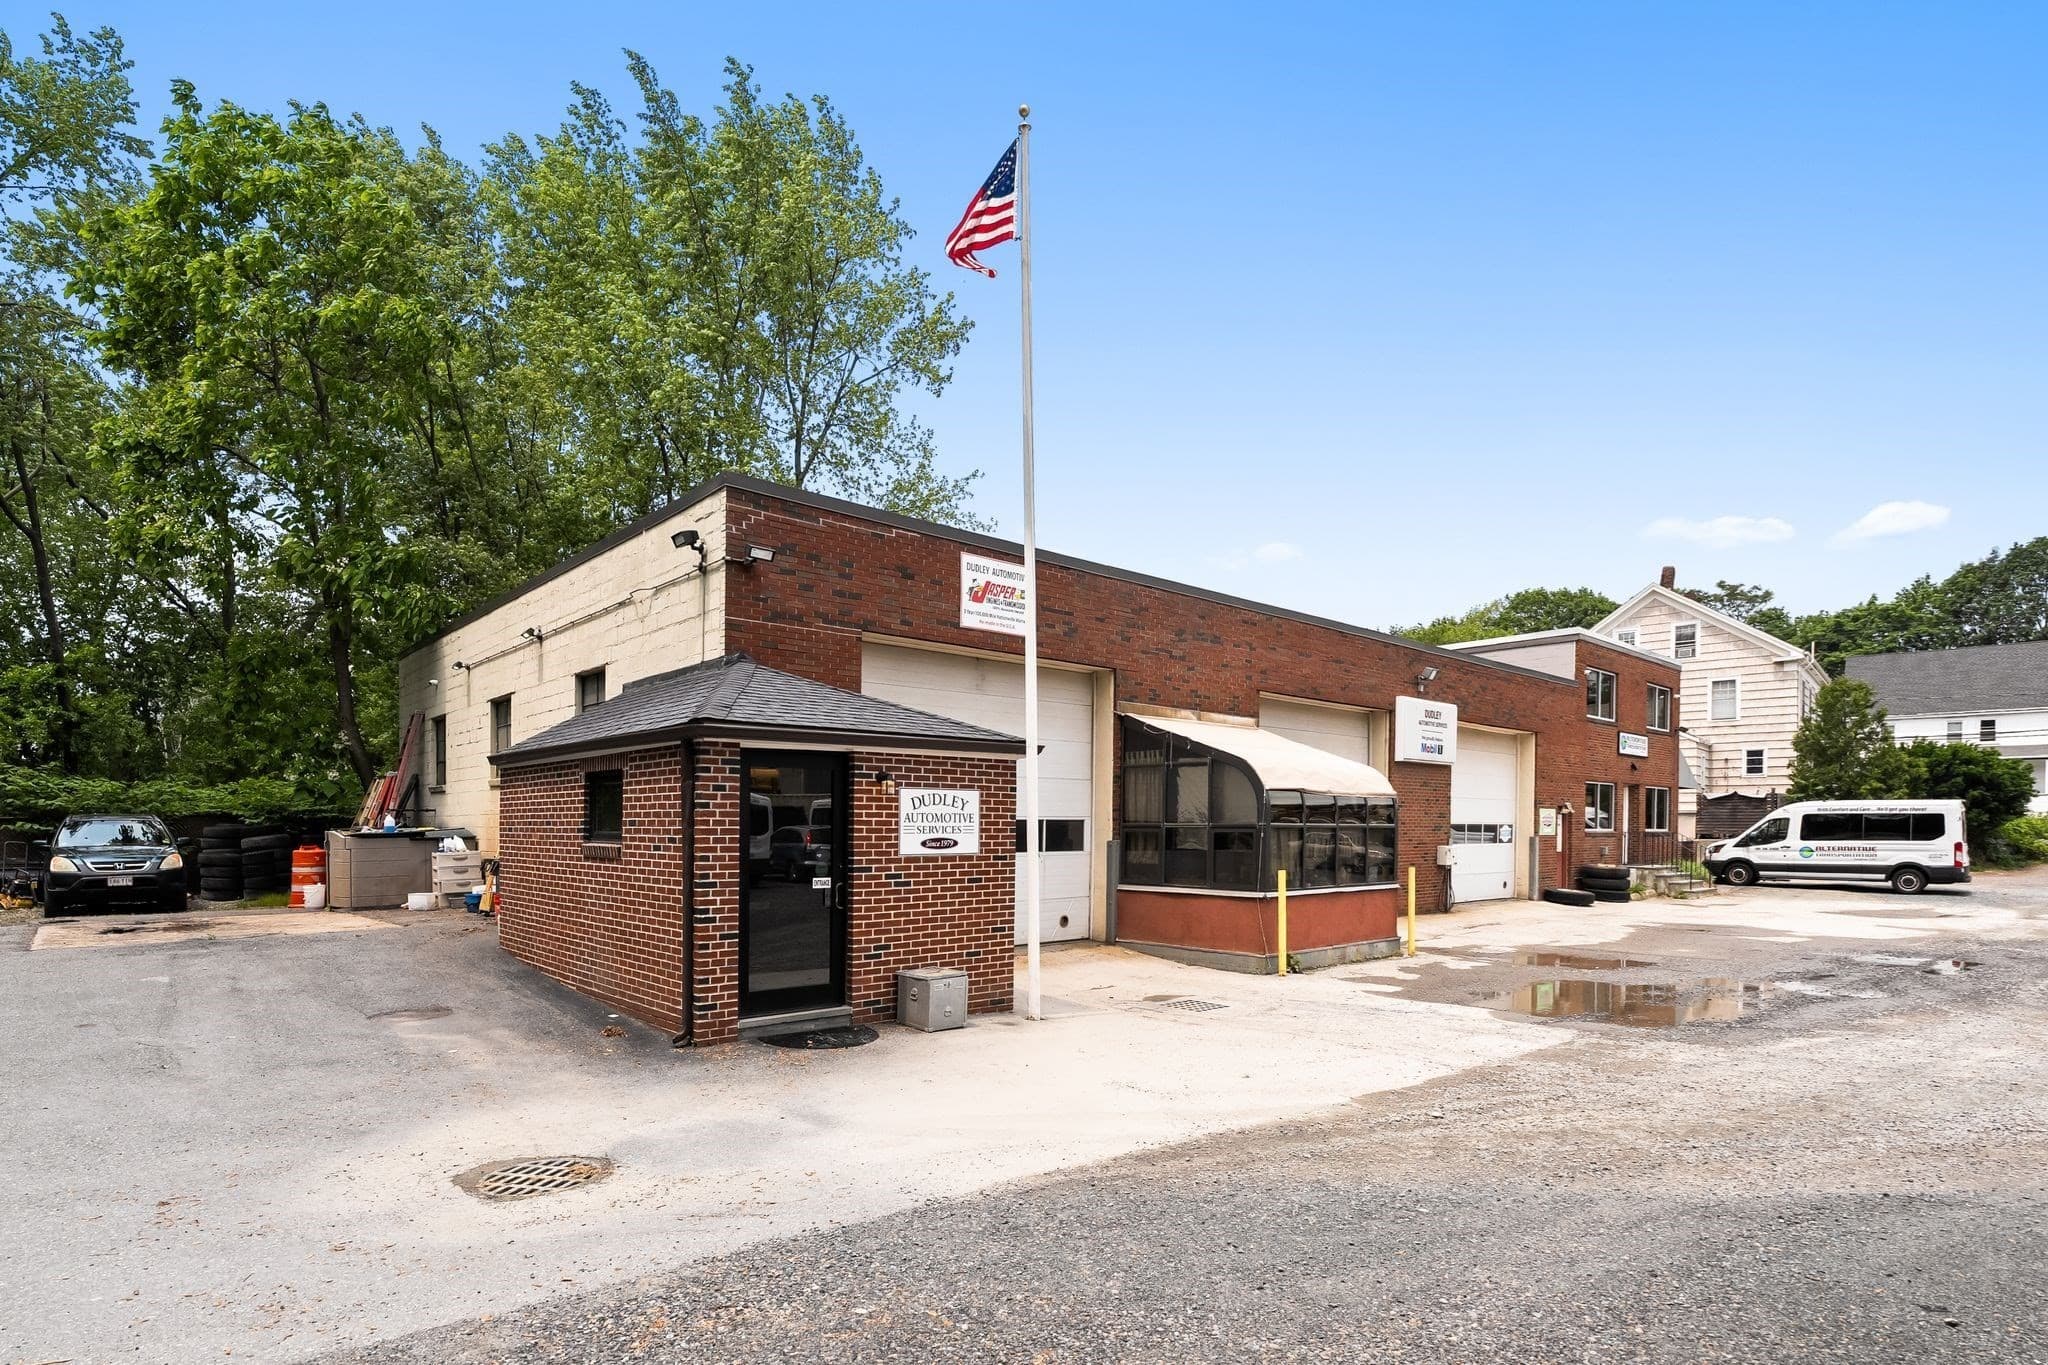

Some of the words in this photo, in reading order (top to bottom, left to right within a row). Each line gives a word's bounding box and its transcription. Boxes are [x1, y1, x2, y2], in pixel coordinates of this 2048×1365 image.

[966, 562, 990, 575] DUDLEY
[992, 568, 1025, 582] AUTOMOTIV
[972, 581, 1016, 603] JASPER
[1421, 742, 1437, 754] Mobil
[911, 793, 969, 810] DUDLEY
[904, 813, 974, 823] AUTOMOTIVE
[916, 826, 962, 834] SERVICES
[926, 840, 940, 848] Since
[941, 840, 953, 848] 1979
